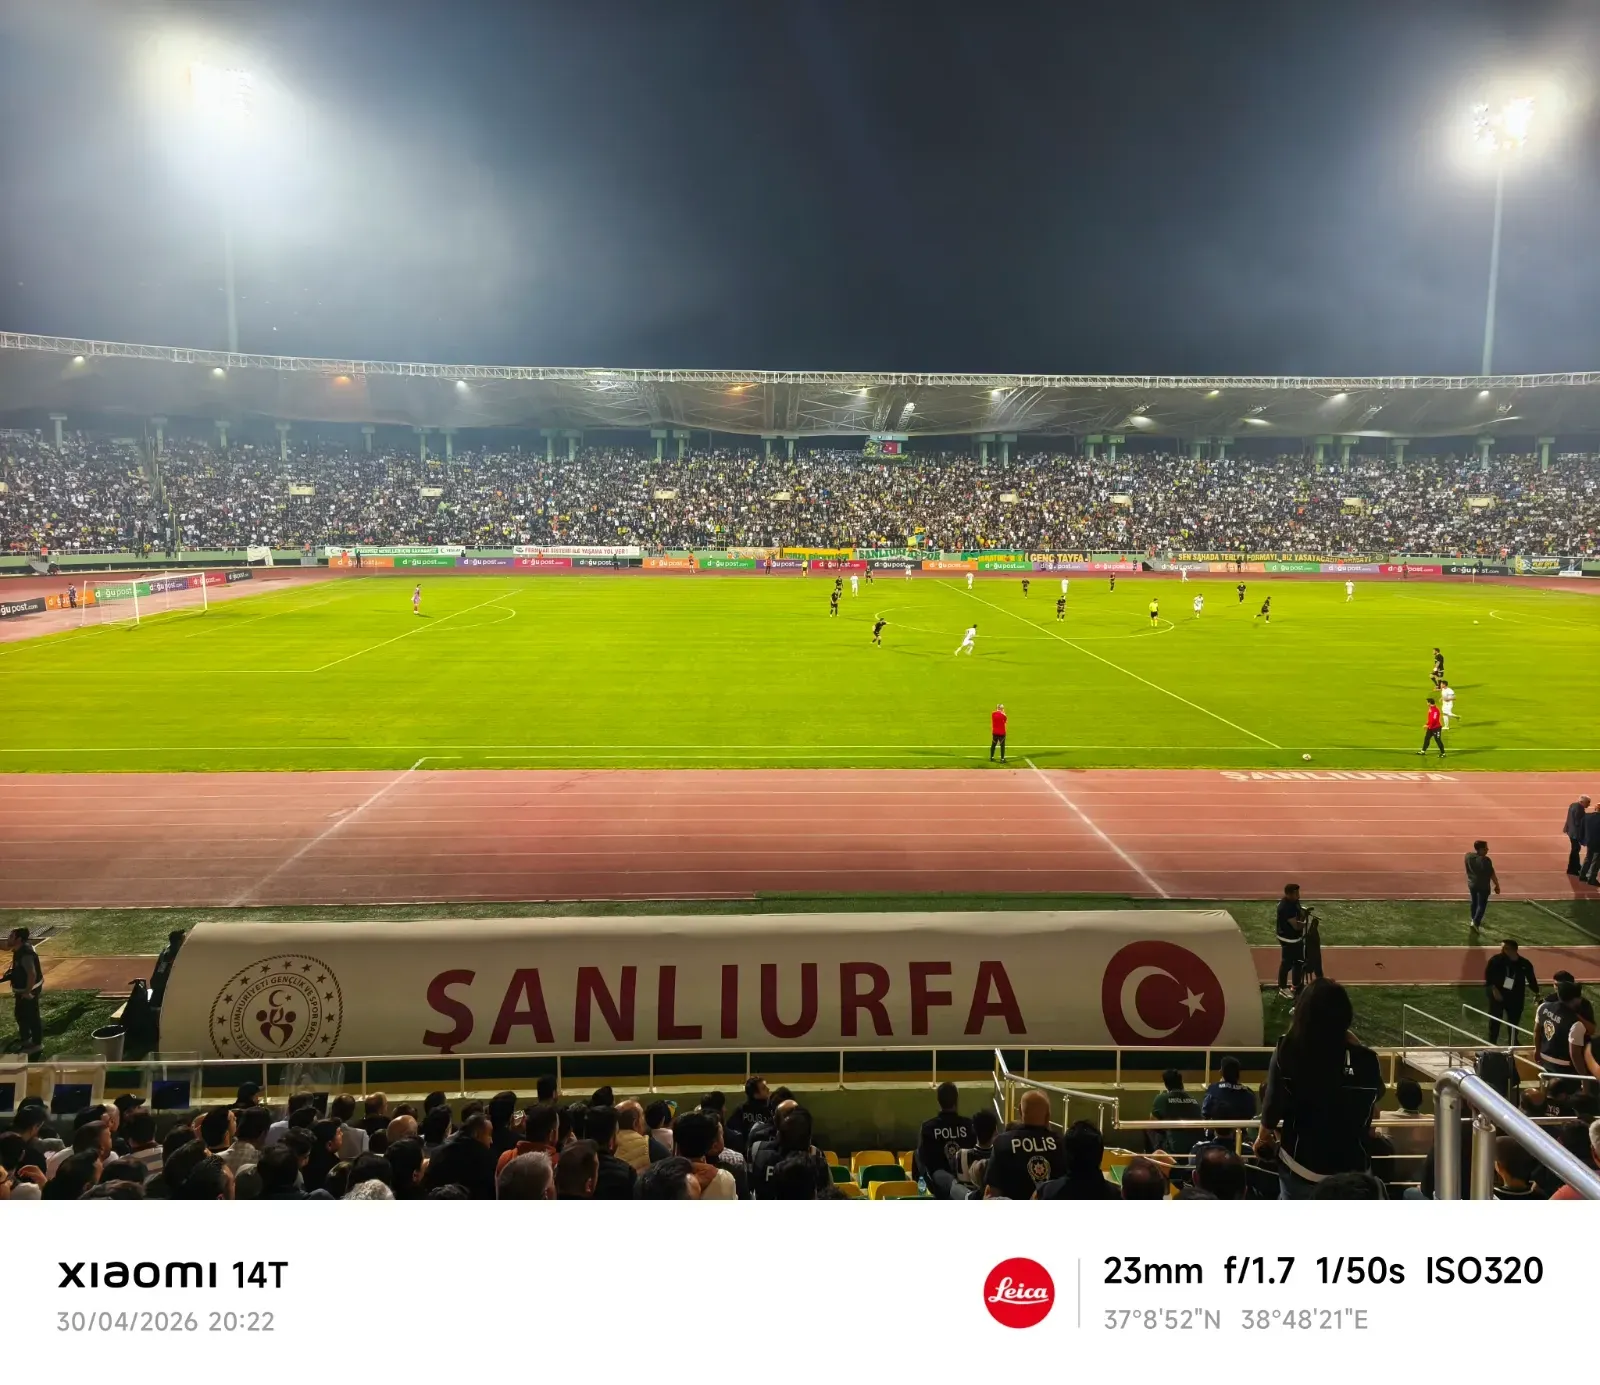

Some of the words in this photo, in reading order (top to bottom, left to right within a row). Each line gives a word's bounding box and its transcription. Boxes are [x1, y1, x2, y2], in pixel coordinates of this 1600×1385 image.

[0, 604, 11, 617] ğu
[270, 976, 306, 988] GENÇLİK
[304, 986, 314, 997] VE
[309, 996, 319, 1019] SPOR
[423, 960, 1027, 1054] ŞANLIURFA
[1011, 1136, 1057, 1153] POLİS
